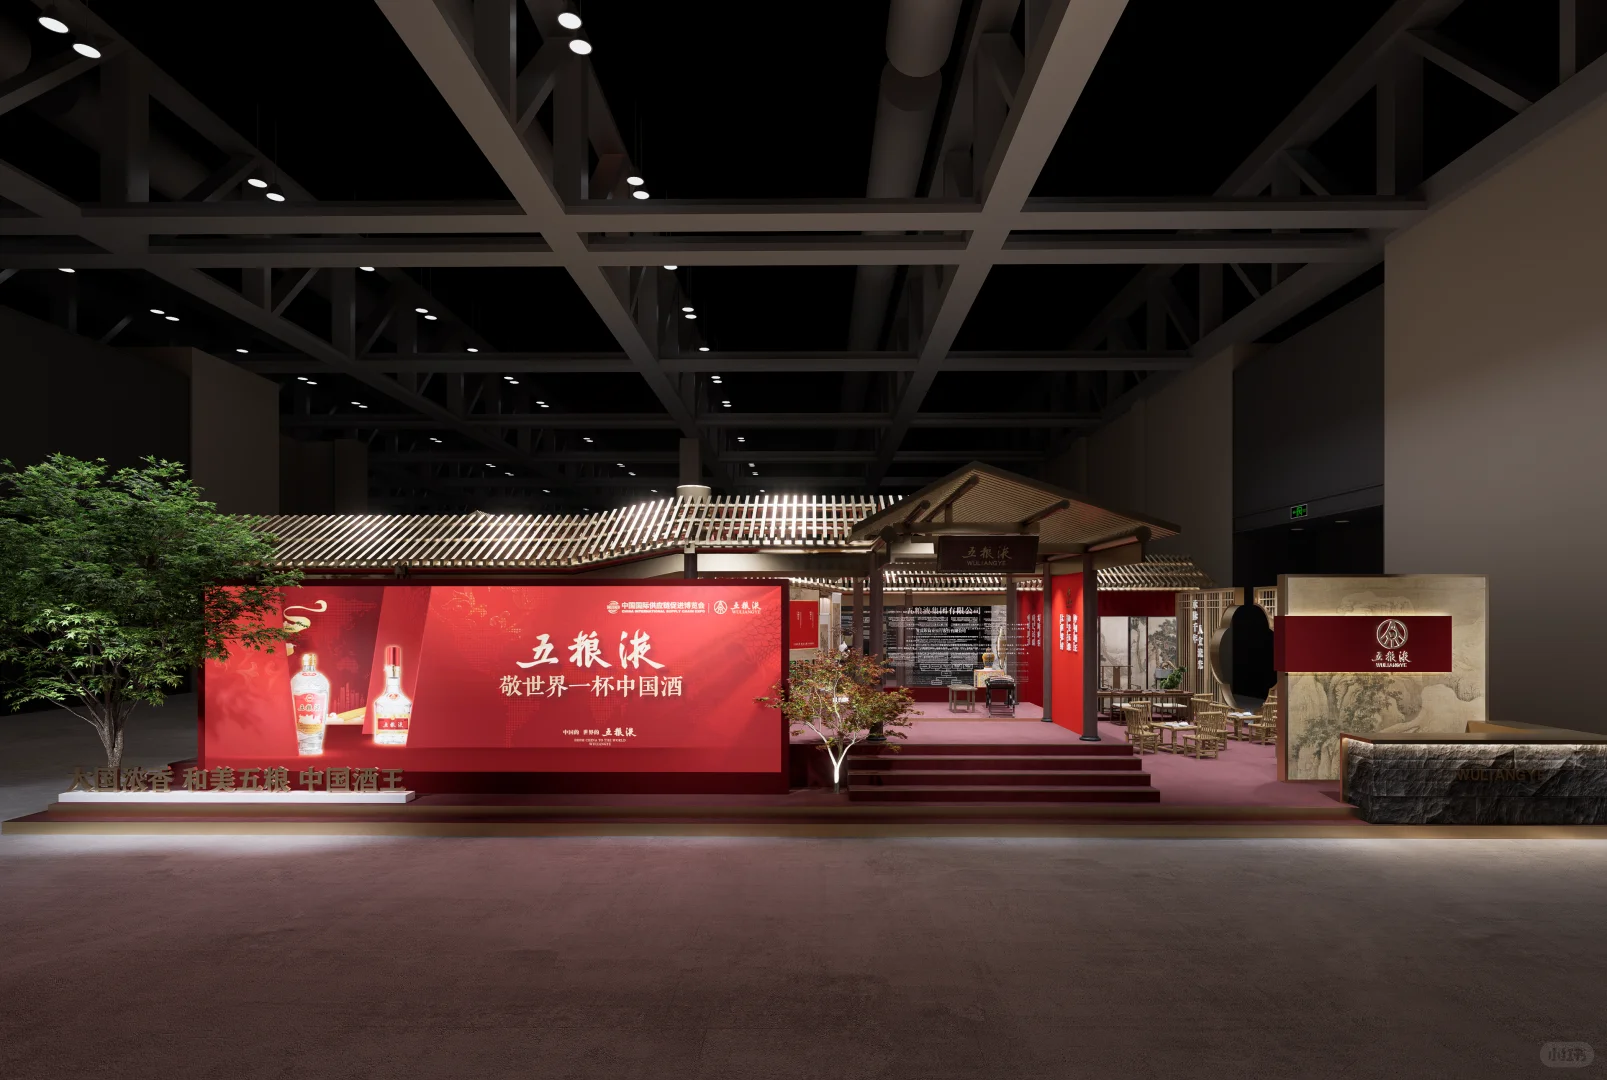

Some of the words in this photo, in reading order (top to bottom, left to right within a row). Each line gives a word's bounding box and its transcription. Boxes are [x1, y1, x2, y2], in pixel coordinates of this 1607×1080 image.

[962, 546, 1012, 560] 五粮液
[621, 602, 705, 610] 中国国际供应链促进博览会
[730, 601, 762, 610] 五粮液
[516, 629, 666, 670] 五粮液
[1371, 650, 1412, 663] 五粮液
[499, 674, 683, 698] 敬世界一杯中国酒
[601, 727, 637, 737] 五粮液
[66, 767, 174, 793] 大国浓香
[182, 766, 291, 793] 和美五粮
[299, 766, 406, 793] 中国酒王
[1457, 769, 1546, 781] WULIANGYE
